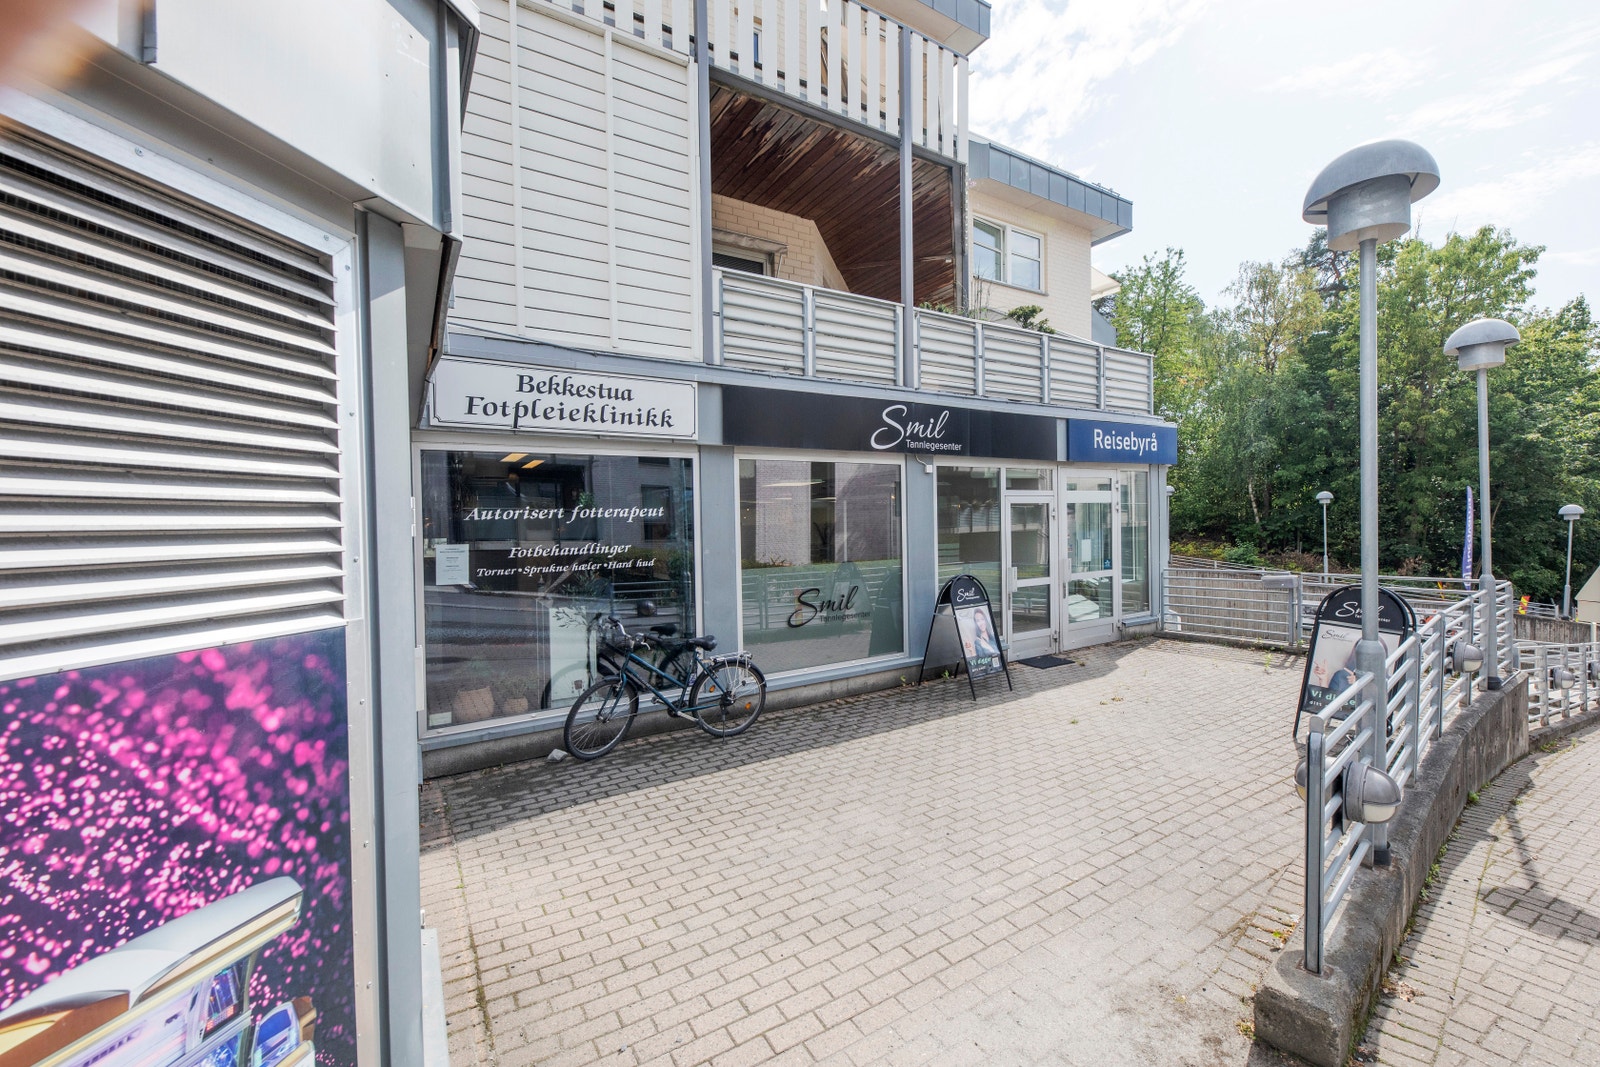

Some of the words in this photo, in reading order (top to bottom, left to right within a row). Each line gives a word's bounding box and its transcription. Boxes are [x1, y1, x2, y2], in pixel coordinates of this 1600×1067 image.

[516, 374, 634, 401] Bekkestua
[464, 395, 675, 429] Fotpleieklinikk
[870, 404, 949, 450] Smil
[906, 439, 962, 452] Tannlegesenter
[1093, 428, 1158, 456] Reisebyrå
[464, 506, 565, 521] Autorisert
[566, 505, 665, 524] fotterapeut
[508, 542, 632, 558] Fotbehandlinger
[476, 568, 517, 577] Torner
[523, 563, 569, 577] Sprukne
[572, 561, 602, 572] hæler
[607, 559, 634, 570] Hard
[635, 557, 656, 568] hud
[787, 585, 859, 628] Smil
[1335, 601, 1385, 617] Sl
[1311, 690, 1322, 698] Vi
